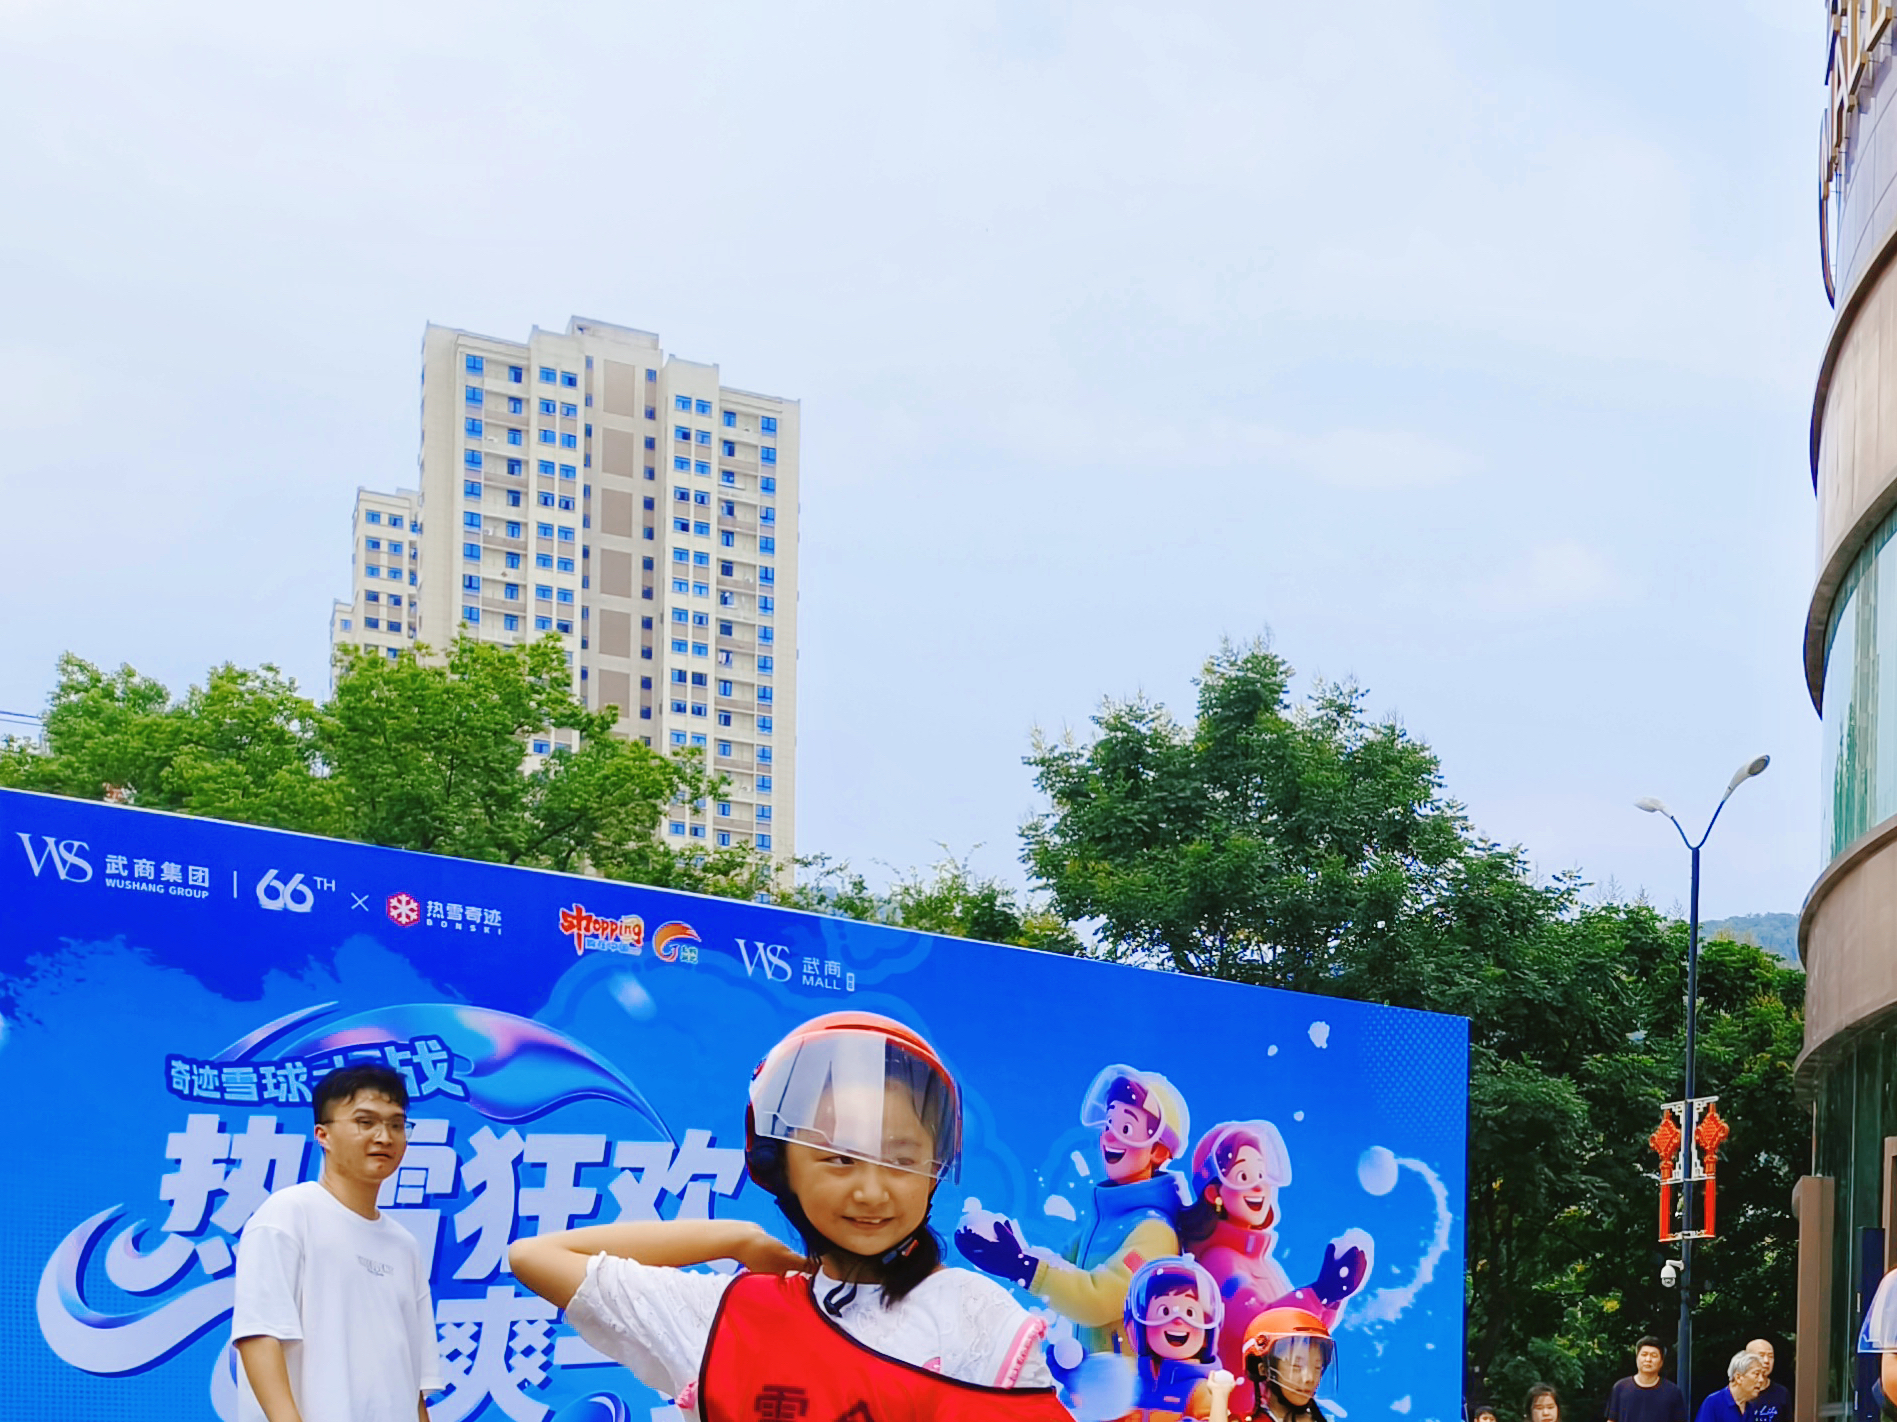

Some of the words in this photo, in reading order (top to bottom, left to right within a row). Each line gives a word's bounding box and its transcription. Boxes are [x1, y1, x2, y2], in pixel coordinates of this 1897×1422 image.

[105, 854, 210, 888] 武商集团
[106, 878, 164, 894] WUSHANG
[168, 885, 209, 899] GROUP
[426, 900, 502, 926] 热雪奇迹
[802, 956, 841, 978] 武商
[802, 975, 841, 991] MALL
